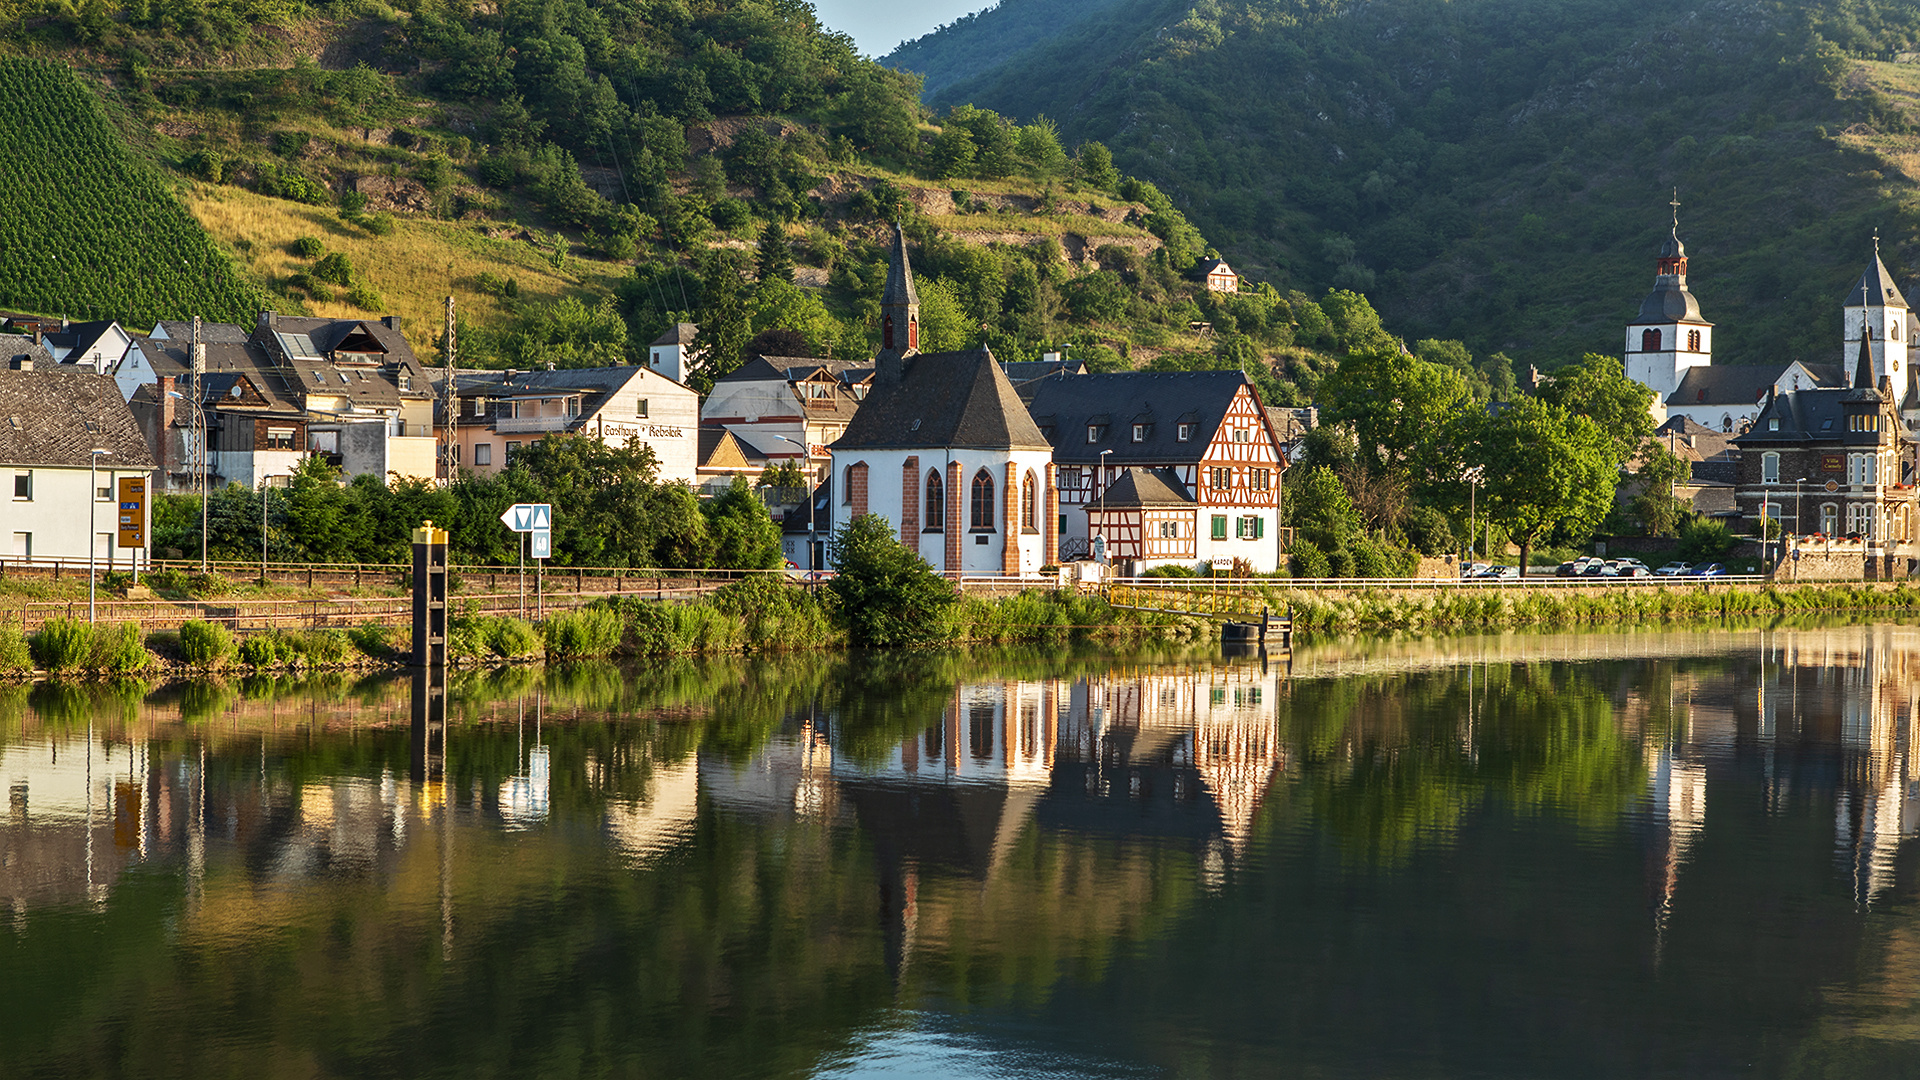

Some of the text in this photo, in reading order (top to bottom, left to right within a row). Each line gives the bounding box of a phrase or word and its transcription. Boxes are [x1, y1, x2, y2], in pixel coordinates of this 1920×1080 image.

[603, 423, 682, 438] Gasthaus Rebstock
[536, 537, 547, 551] 40
